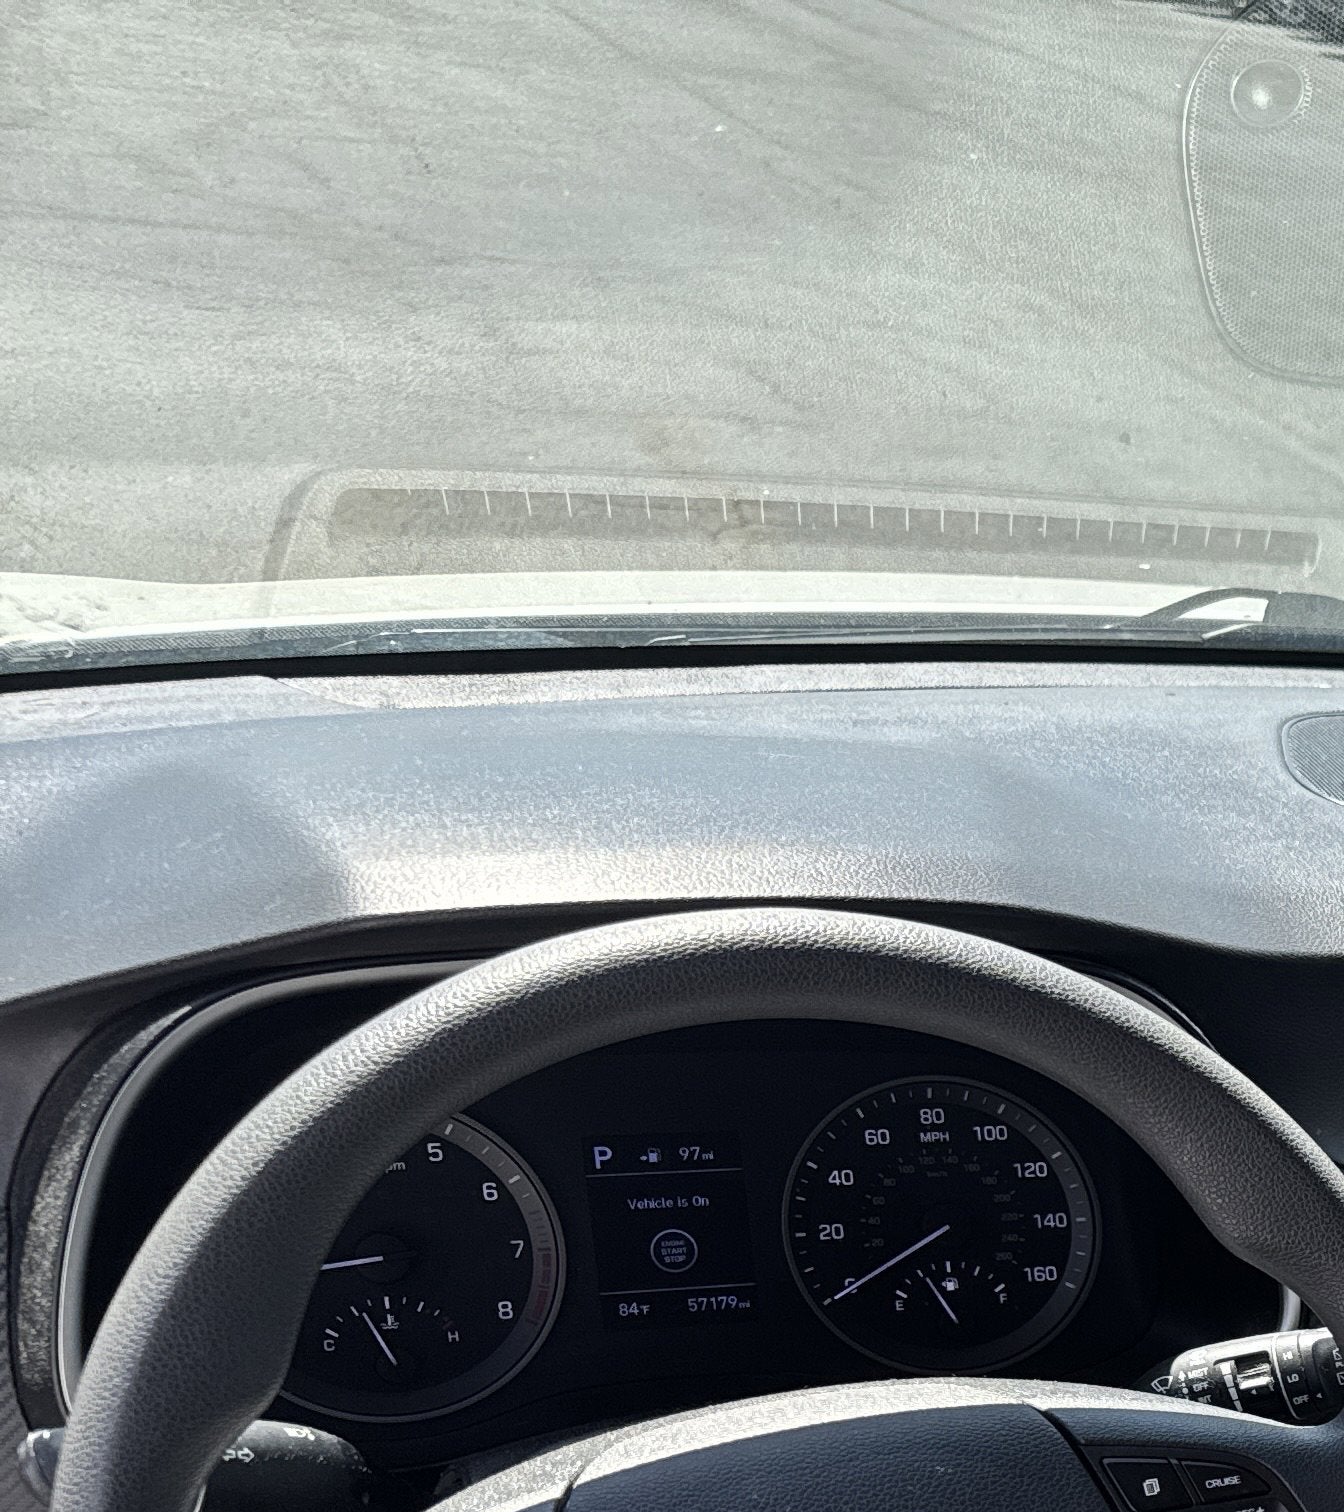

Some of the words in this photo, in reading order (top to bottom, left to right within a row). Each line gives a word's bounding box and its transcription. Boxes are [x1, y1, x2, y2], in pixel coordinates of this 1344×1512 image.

[920, 1108, 945, 1124] 80
[864, 1129, 890, 1145] 60
[920, 1131, 950, 1143] MPH
[972, 1125, 1008, 1141] 100
[427, 1143, 444, 1161] 5
[593, 1146, 613, 1169] P
[828, 1170, 855, 1186] 40
[1013, 1162, 1048, 1178] 120
[482, 1182, 498, 1201] 6
[627, 1198, 674, 1210] Vehicle
[677, 1196, 689, 1208] is
[692, 1195, 710, 1207] On
[1033, 1212, 1067, 1229] 140
[819, 1223, 845, 1240] 20
[509, 1240, 524, 1258] 7
[661, 1247, 687, 1256] START
[664, 1255, 687, 1263] STOP
[1023, 1266, 1058, 1282] 160
[896, 1300, 905, 1312] E
[1000, 1293, 1008, 1304] F
[498, 1301, 514, 1320] 8
[447, 1331, 460, 1343] H
[323, 1340, 336, 1352] C
[1282, 1350, 1294, 1361] HI
[1287, 1373, 1299, 1384] LO
[1292, 1394, 1310, 1405] OFF
[1205, 1475, 1242, 1489] CRUISE
